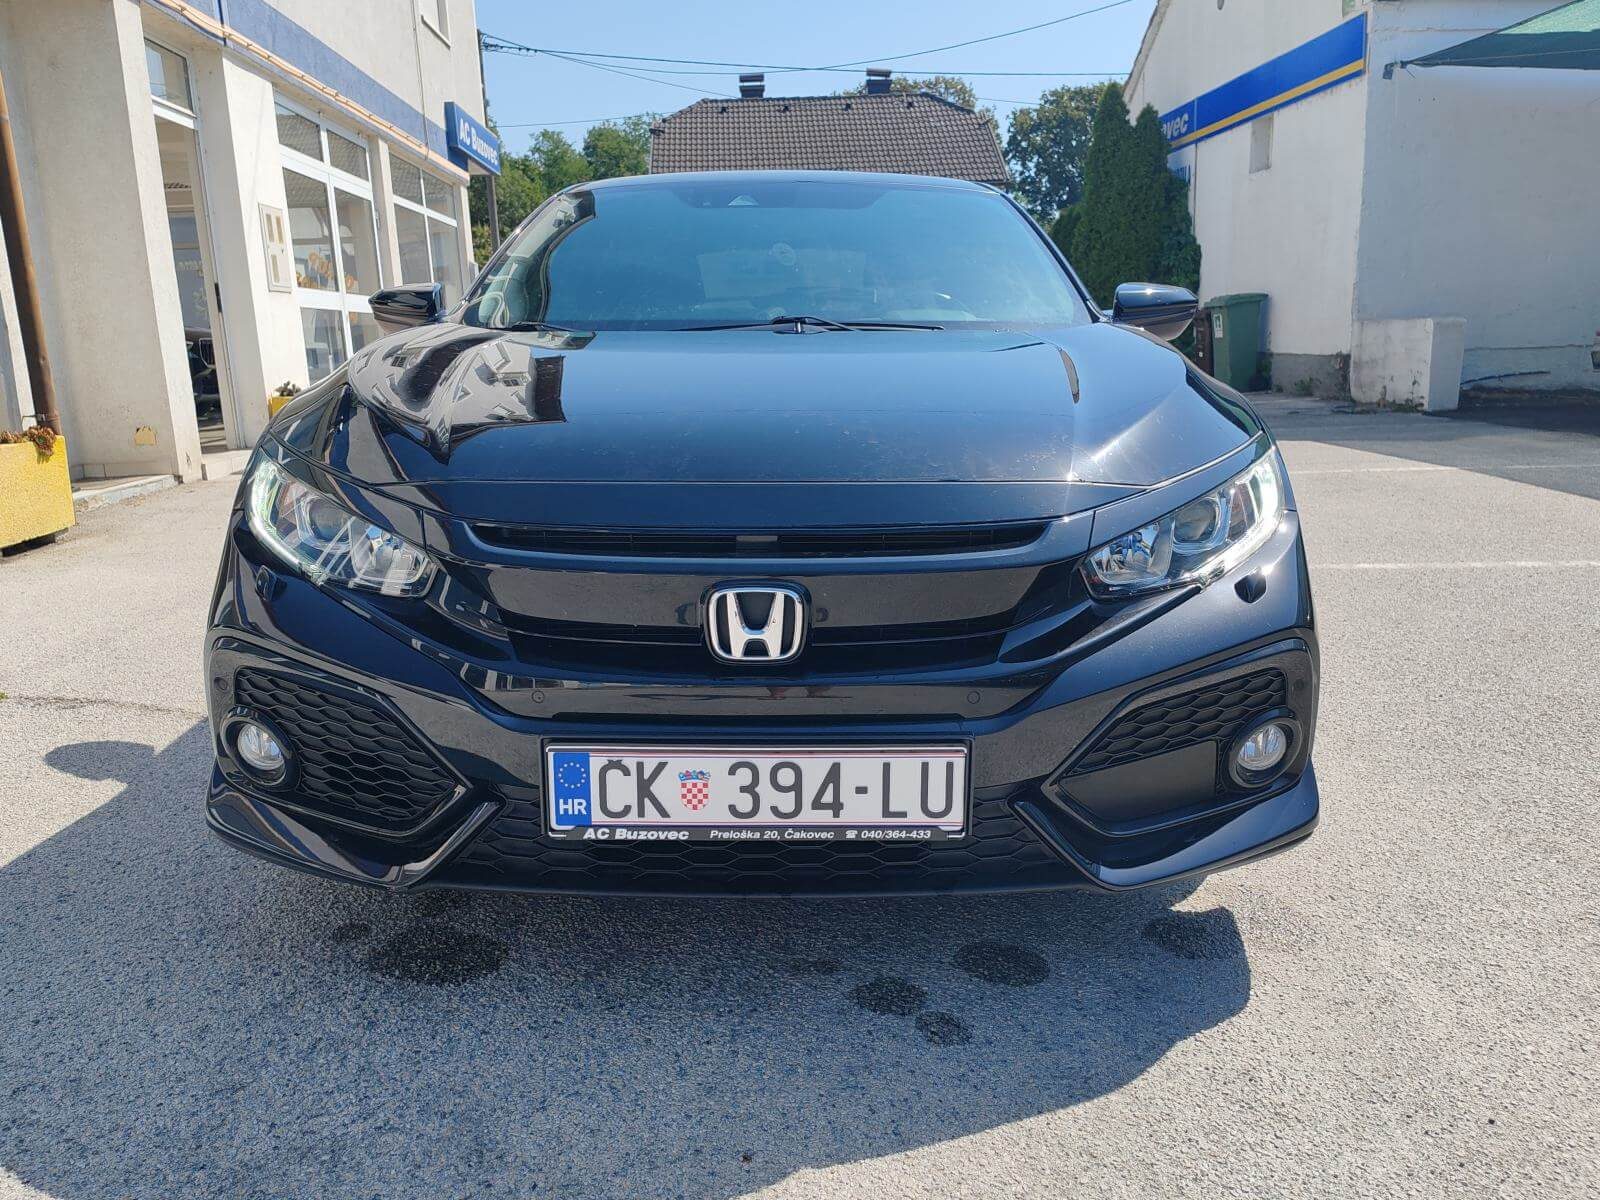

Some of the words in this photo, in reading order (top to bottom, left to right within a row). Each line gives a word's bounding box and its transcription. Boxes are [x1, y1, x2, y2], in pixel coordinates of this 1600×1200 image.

[460, 118, 470, 146] AC
[599, 759, 671, 819] ČK
[559, 799, 587, 815] HR
[583, 828, 609, 840] AC
[615, 829, 690, 840] Buzovec
[710, 830, 760, 839] Preloška
[763, 830, 780, 840] 20,
[784, 828, 835, 839] Čakovec
[861, 830, 931, 839] 040/364-433
